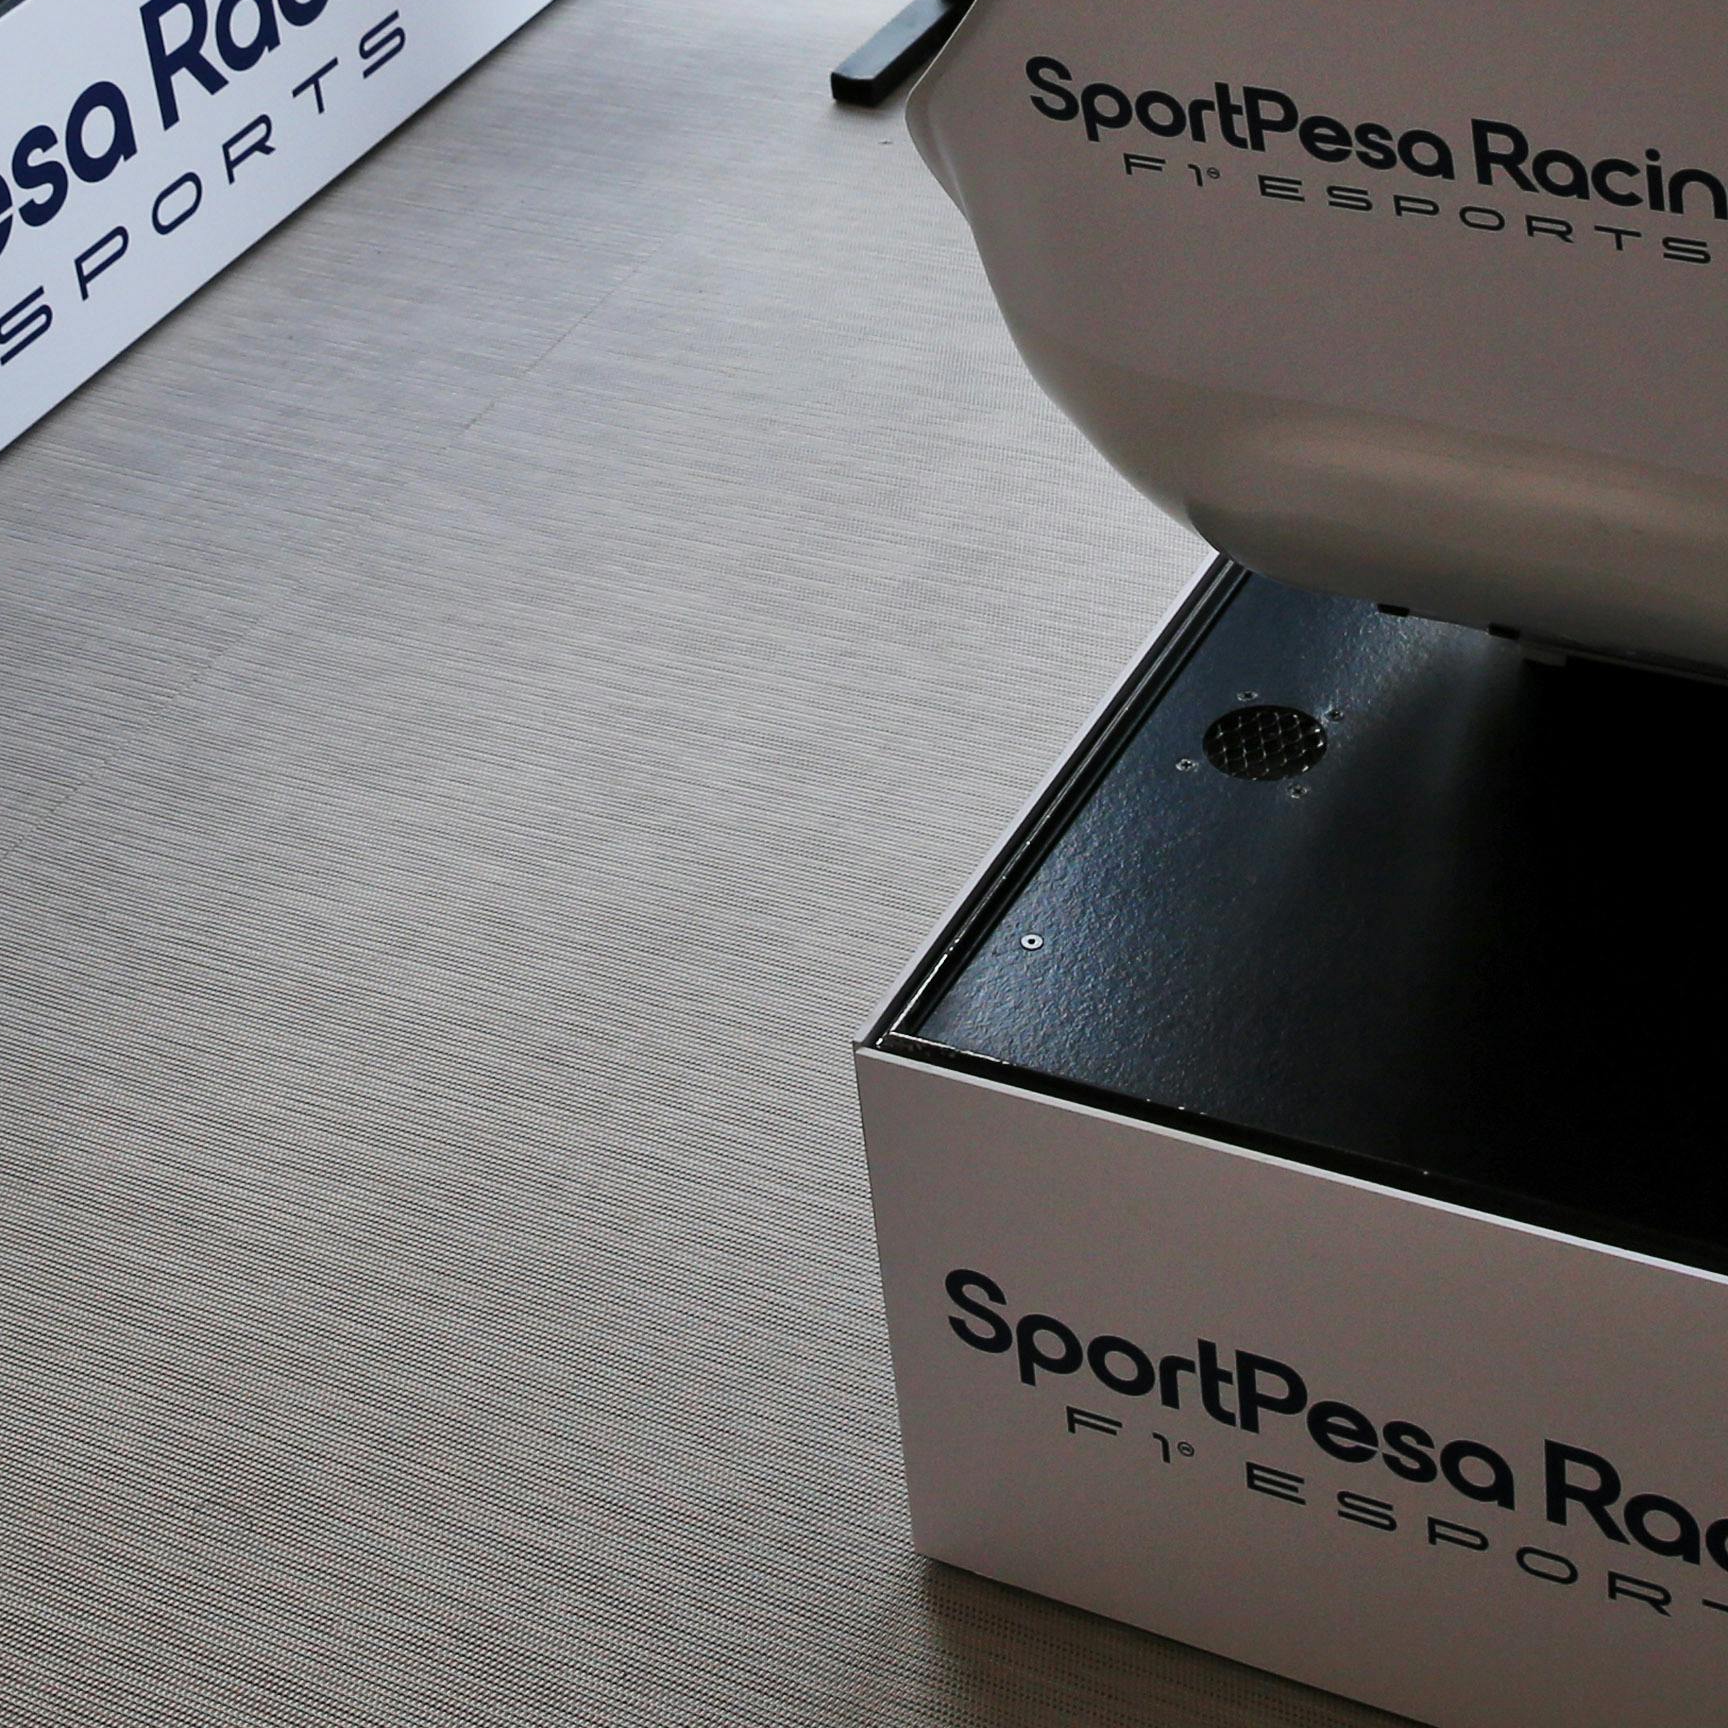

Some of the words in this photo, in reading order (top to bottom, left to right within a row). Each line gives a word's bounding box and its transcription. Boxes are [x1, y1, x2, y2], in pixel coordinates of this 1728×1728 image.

[1025, 55, 1455, 181] SportPesa
[1259, 173, 1712, 265] ESPORTS
[944, 1268, 1516, 1511] SportPesa
